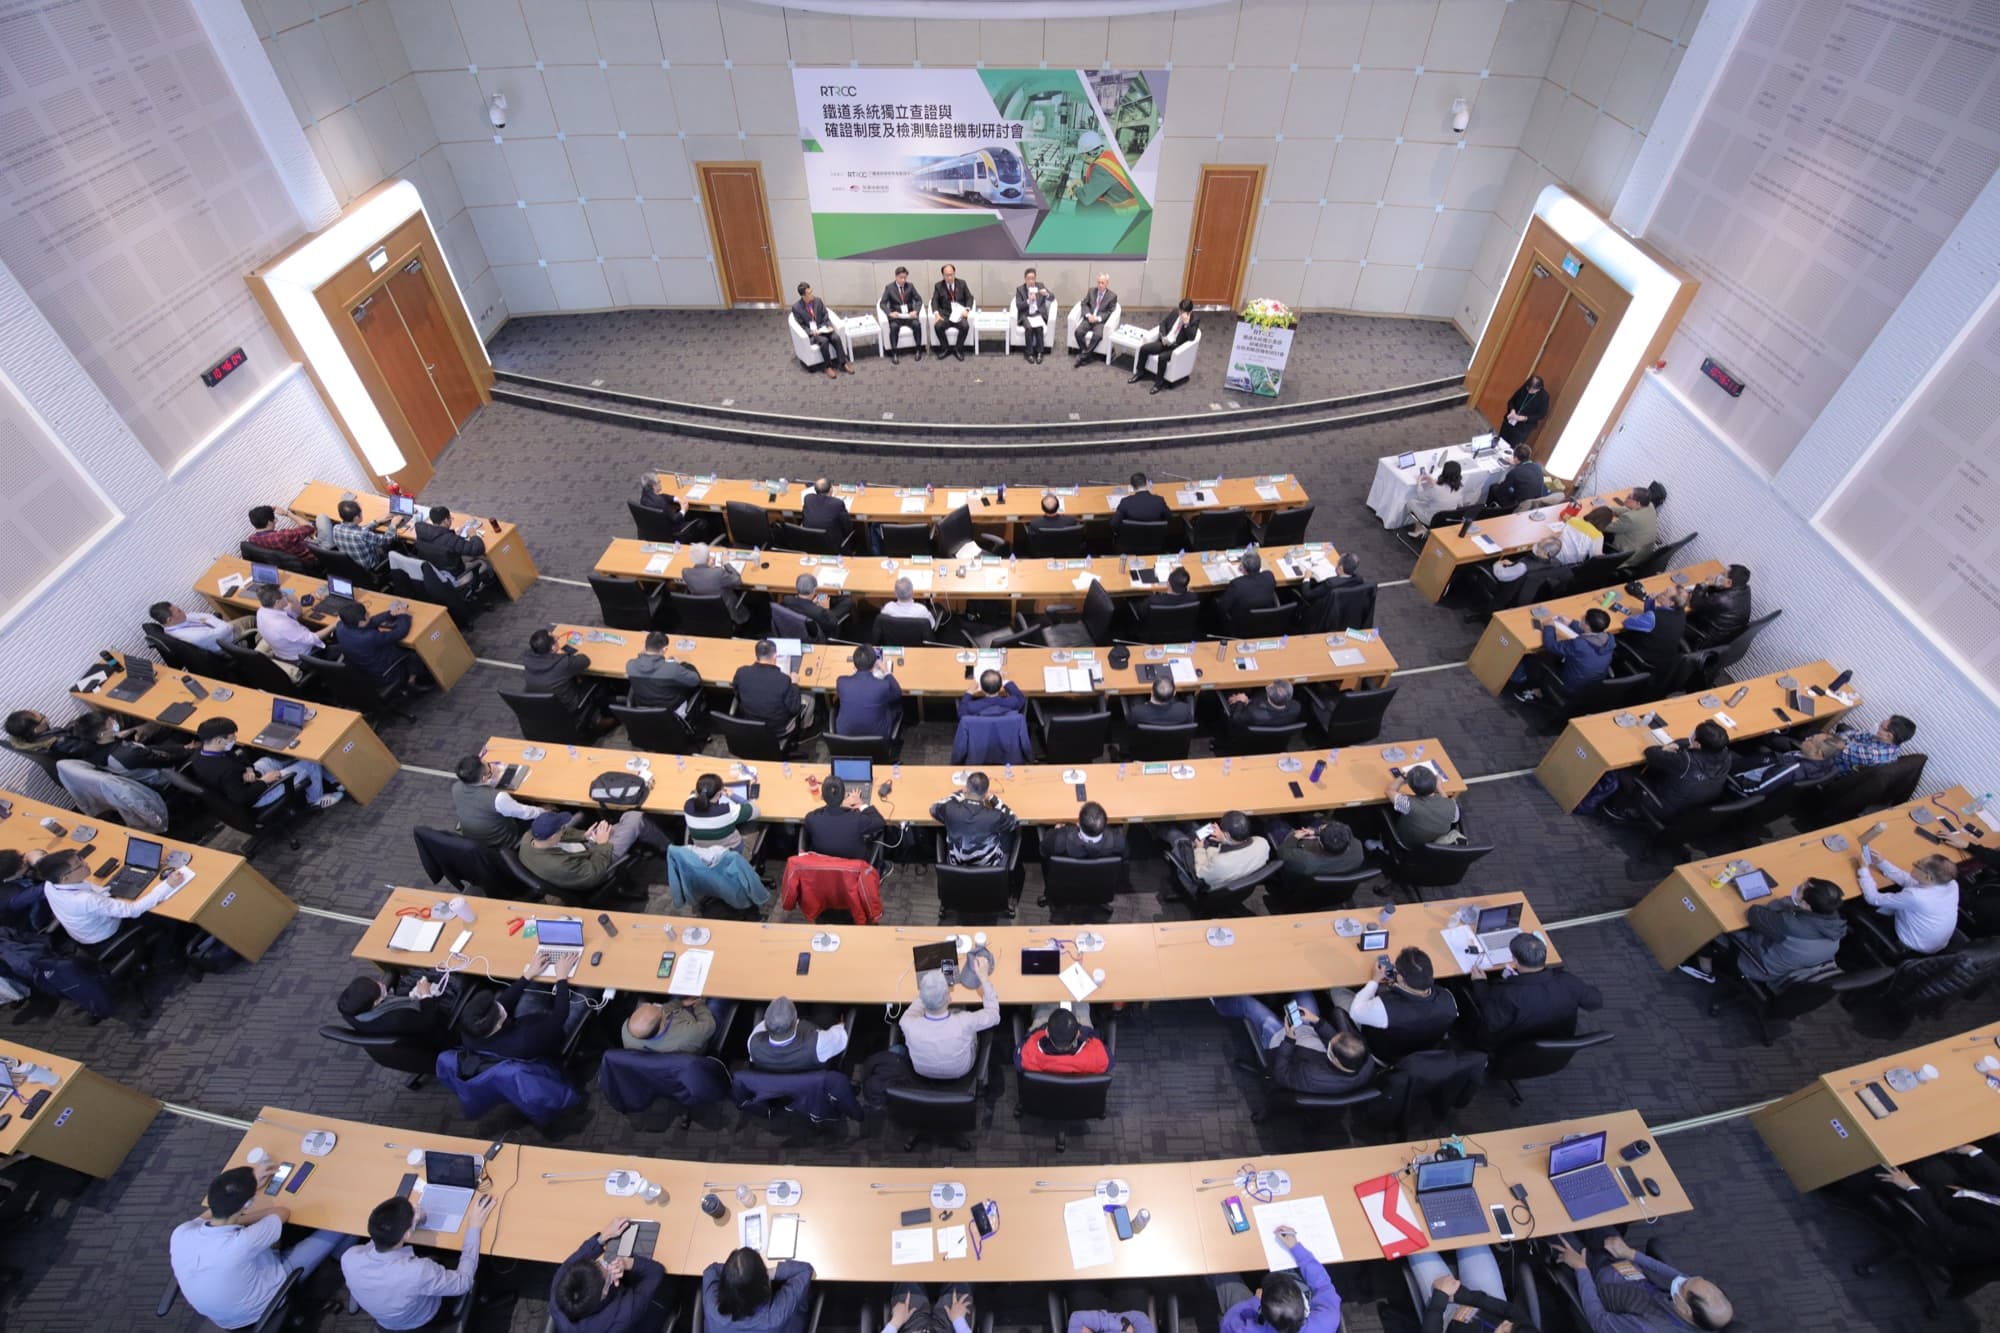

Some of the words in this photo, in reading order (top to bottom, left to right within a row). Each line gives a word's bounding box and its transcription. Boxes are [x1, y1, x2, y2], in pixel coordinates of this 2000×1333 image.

[820, 86, 857, 97] RTRCC
[822, 104, 953, 120] 鐵道系統獨立查證與
[825, 122, 1024, 139] 確證制度及檢測驗證機制研討會
